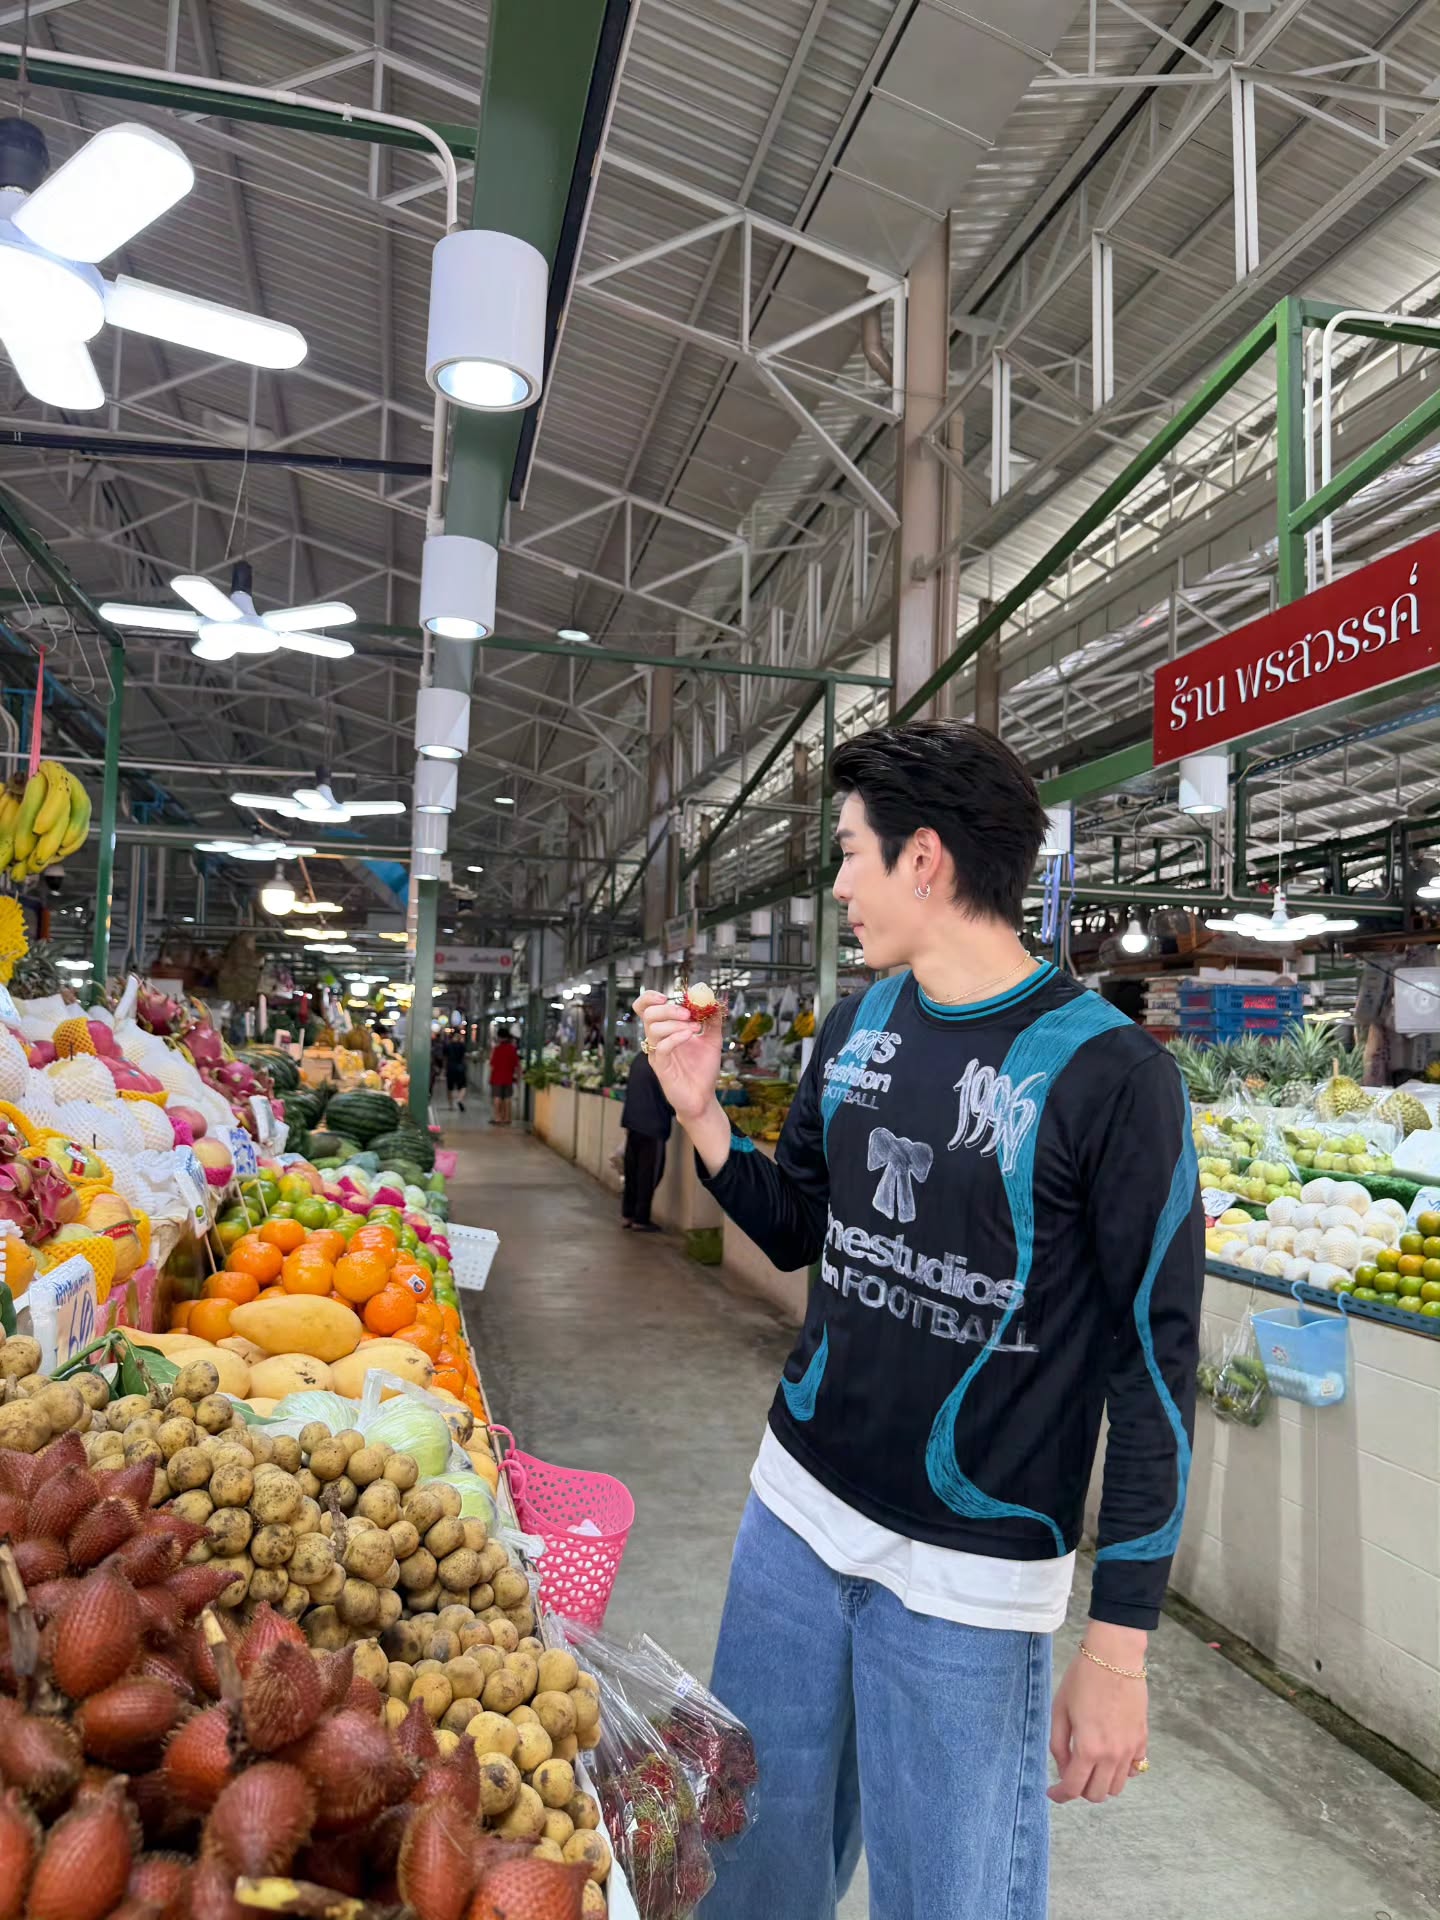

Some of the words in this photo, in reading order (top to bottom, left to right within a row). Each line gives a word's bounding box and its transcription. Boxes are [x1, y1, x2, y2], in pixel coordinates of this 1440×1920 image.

[1170, 676, 1226, 731] ร้าน
[1235, 562, 1420, 703] พรสวรรค์
[823, 1057, 892, 1093] fashion
[827, 1203, 1026, 1310] nestudios
[842, 1265, 1039, 1352] FOOTBALL
